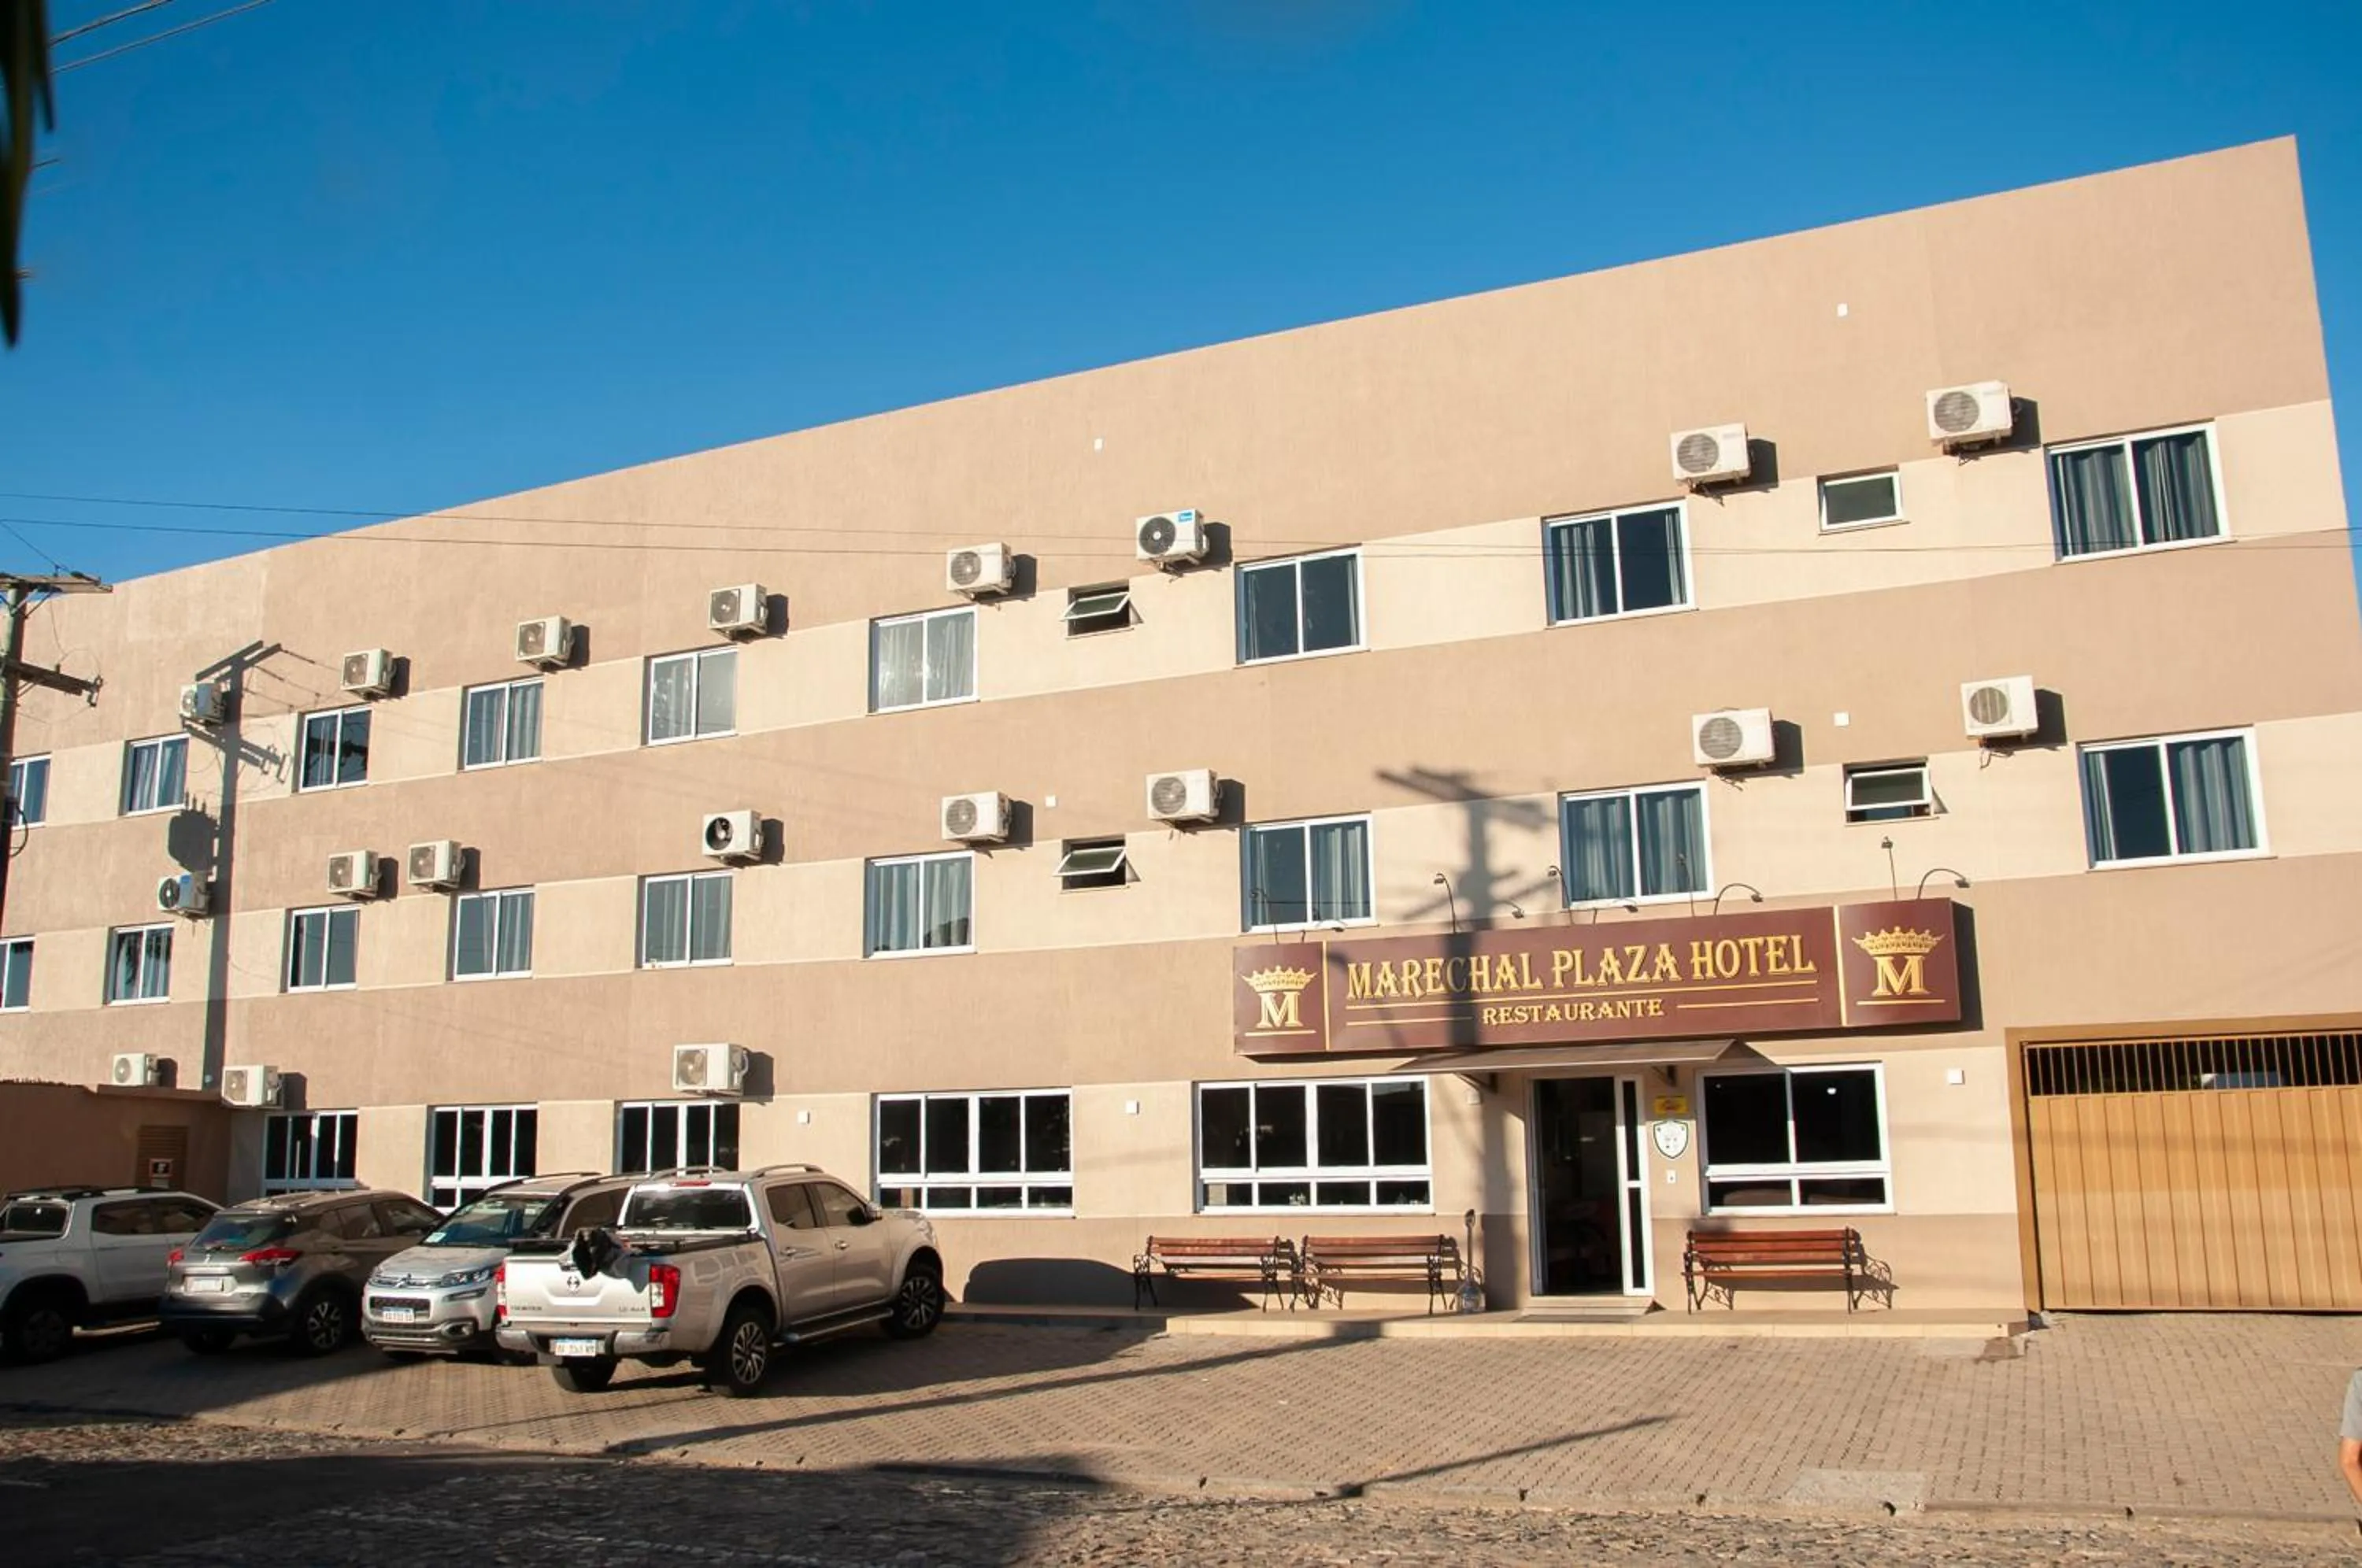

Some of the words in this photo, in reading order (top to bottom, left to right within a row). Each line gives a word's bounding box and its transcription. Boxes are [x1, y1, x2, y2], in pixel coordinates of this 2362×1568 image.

[1346, 952, 1544, 1000] MARECHAL
[1552, 944, 1681, 988] PLAZA
[1690, 934, 1817, 981] HOTEL
[1483, 998, 1664, 1026] RESTAURANTE
